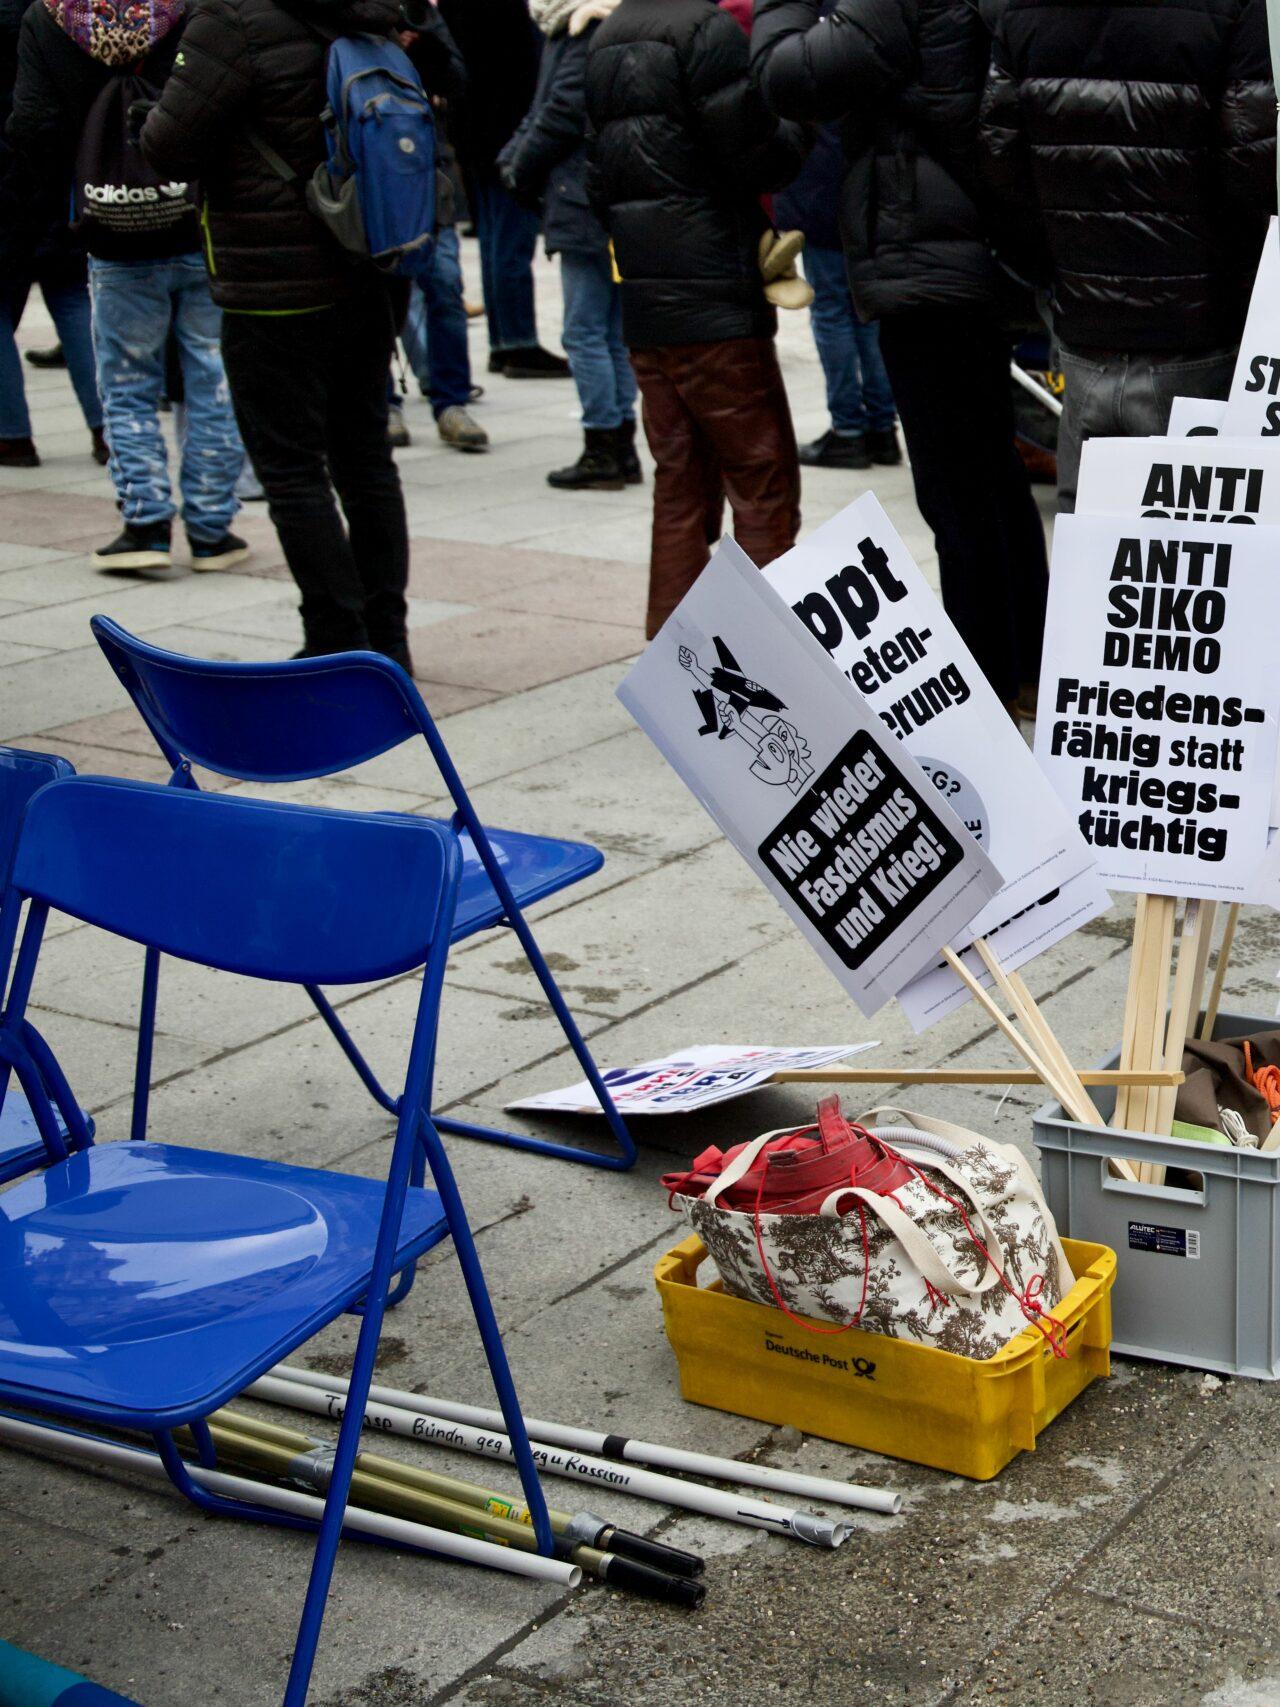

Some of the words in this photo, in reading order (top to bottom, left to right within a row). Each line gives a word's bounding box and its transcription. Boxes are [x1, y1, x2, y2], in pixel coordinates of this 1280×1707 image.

[84, 183, 158, 203] adidas
[1141, 463, 1264, 513] ANTI
[1109, 538, 1232, 588] ANTI
[791, 536, 908, 660] ppt
[1107, 584, 1226, 634] SIKO
[1103, 631, 1221, 674] DEMO
[1055, 678, 1265, 727] Friedens-
[1051, 721, 1161, 767] fähig
[1169, 736, 1245, 771] statt
[1082, 766, 1240, 814] kriegs-
[769, 833, 821, 882] Nie
[810, 749, 886, 839] wieder
[1078, 809, 1228, 861] tüchtig
[798, 787, 917, 918] Faschismus
[834, 887, 886, 949] und
[869, 822, 947, 908] Krieg!
[766, 1340, 820, 1363] Deutsche
[823, 1354, 849, 1371] Post
[477, 1436, 503, 1452] geg
